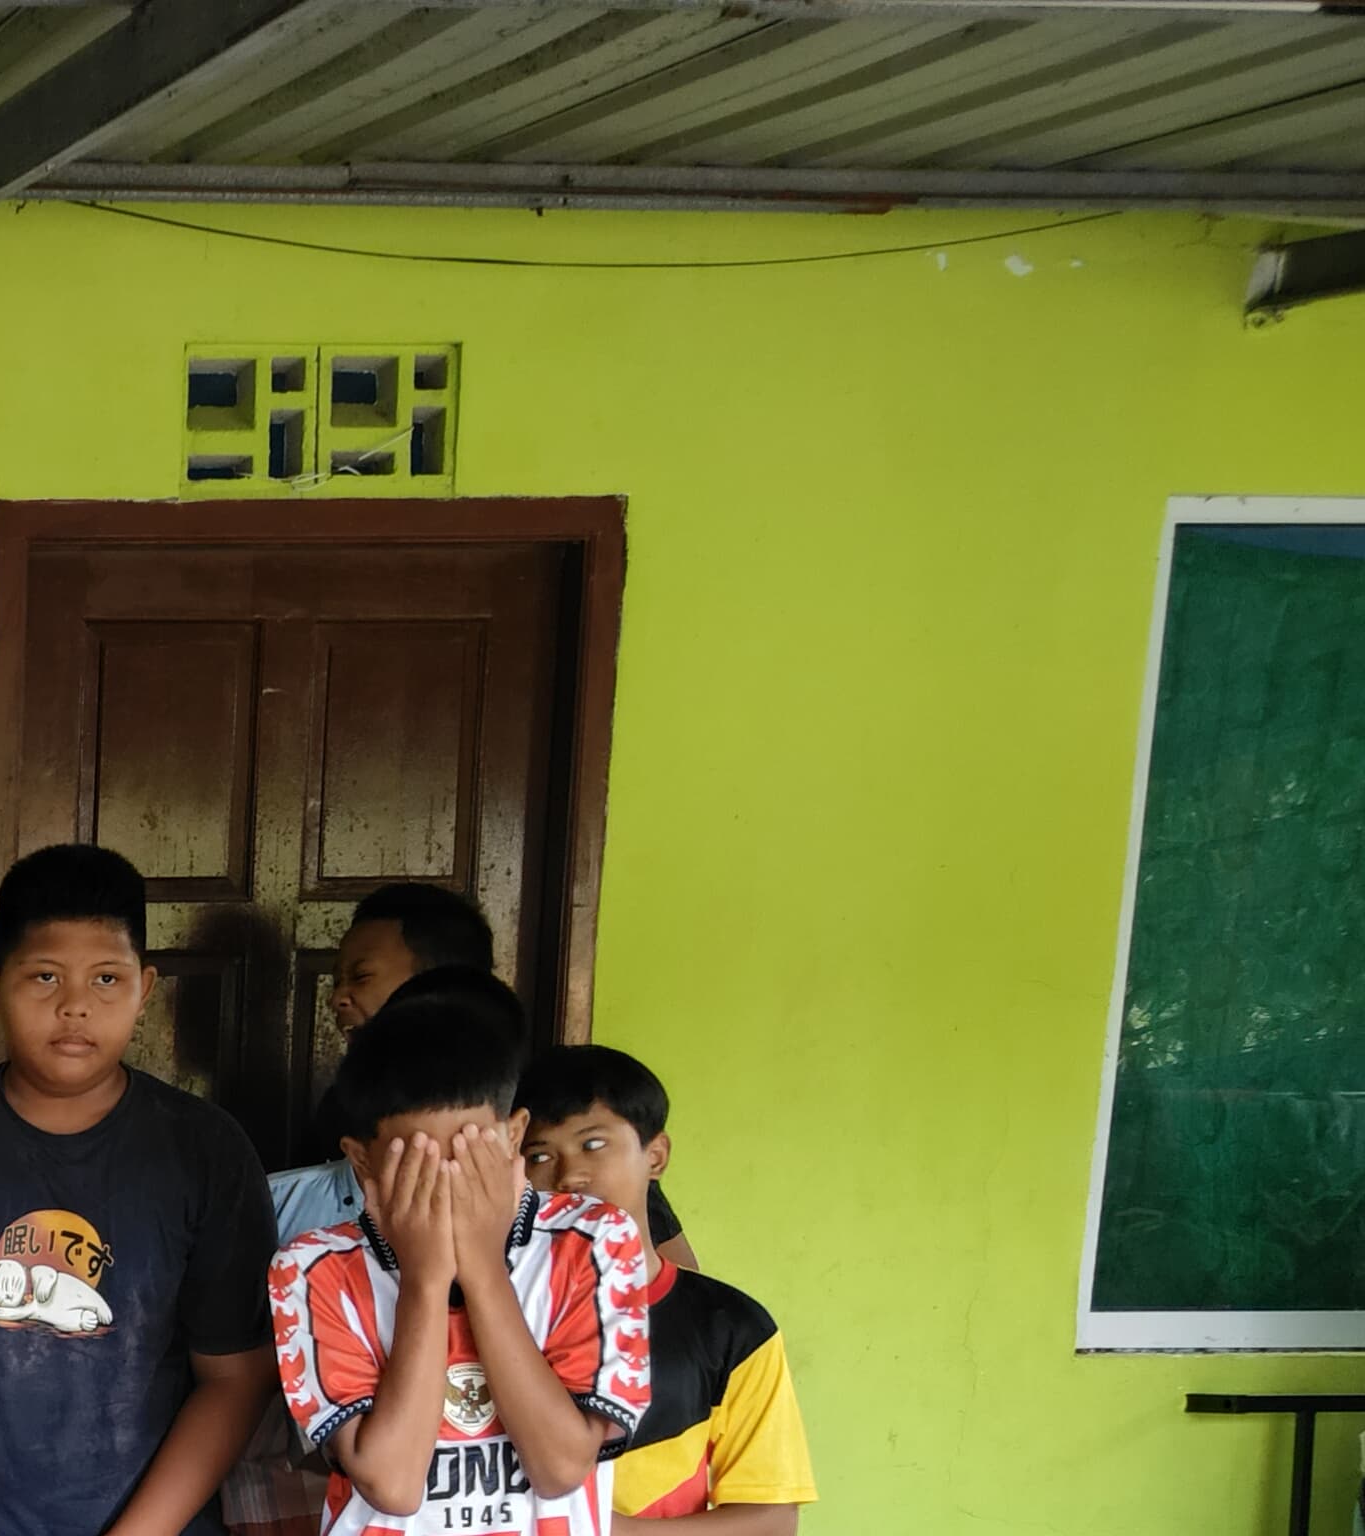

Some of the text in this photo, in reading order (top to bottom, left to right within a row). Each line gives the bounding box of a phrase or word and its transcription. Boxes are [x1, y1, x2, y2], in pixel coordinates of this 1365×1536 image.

[4, 1224, 114, 1278] 眠いです
[443, 1502, 514, 1529] 1945
